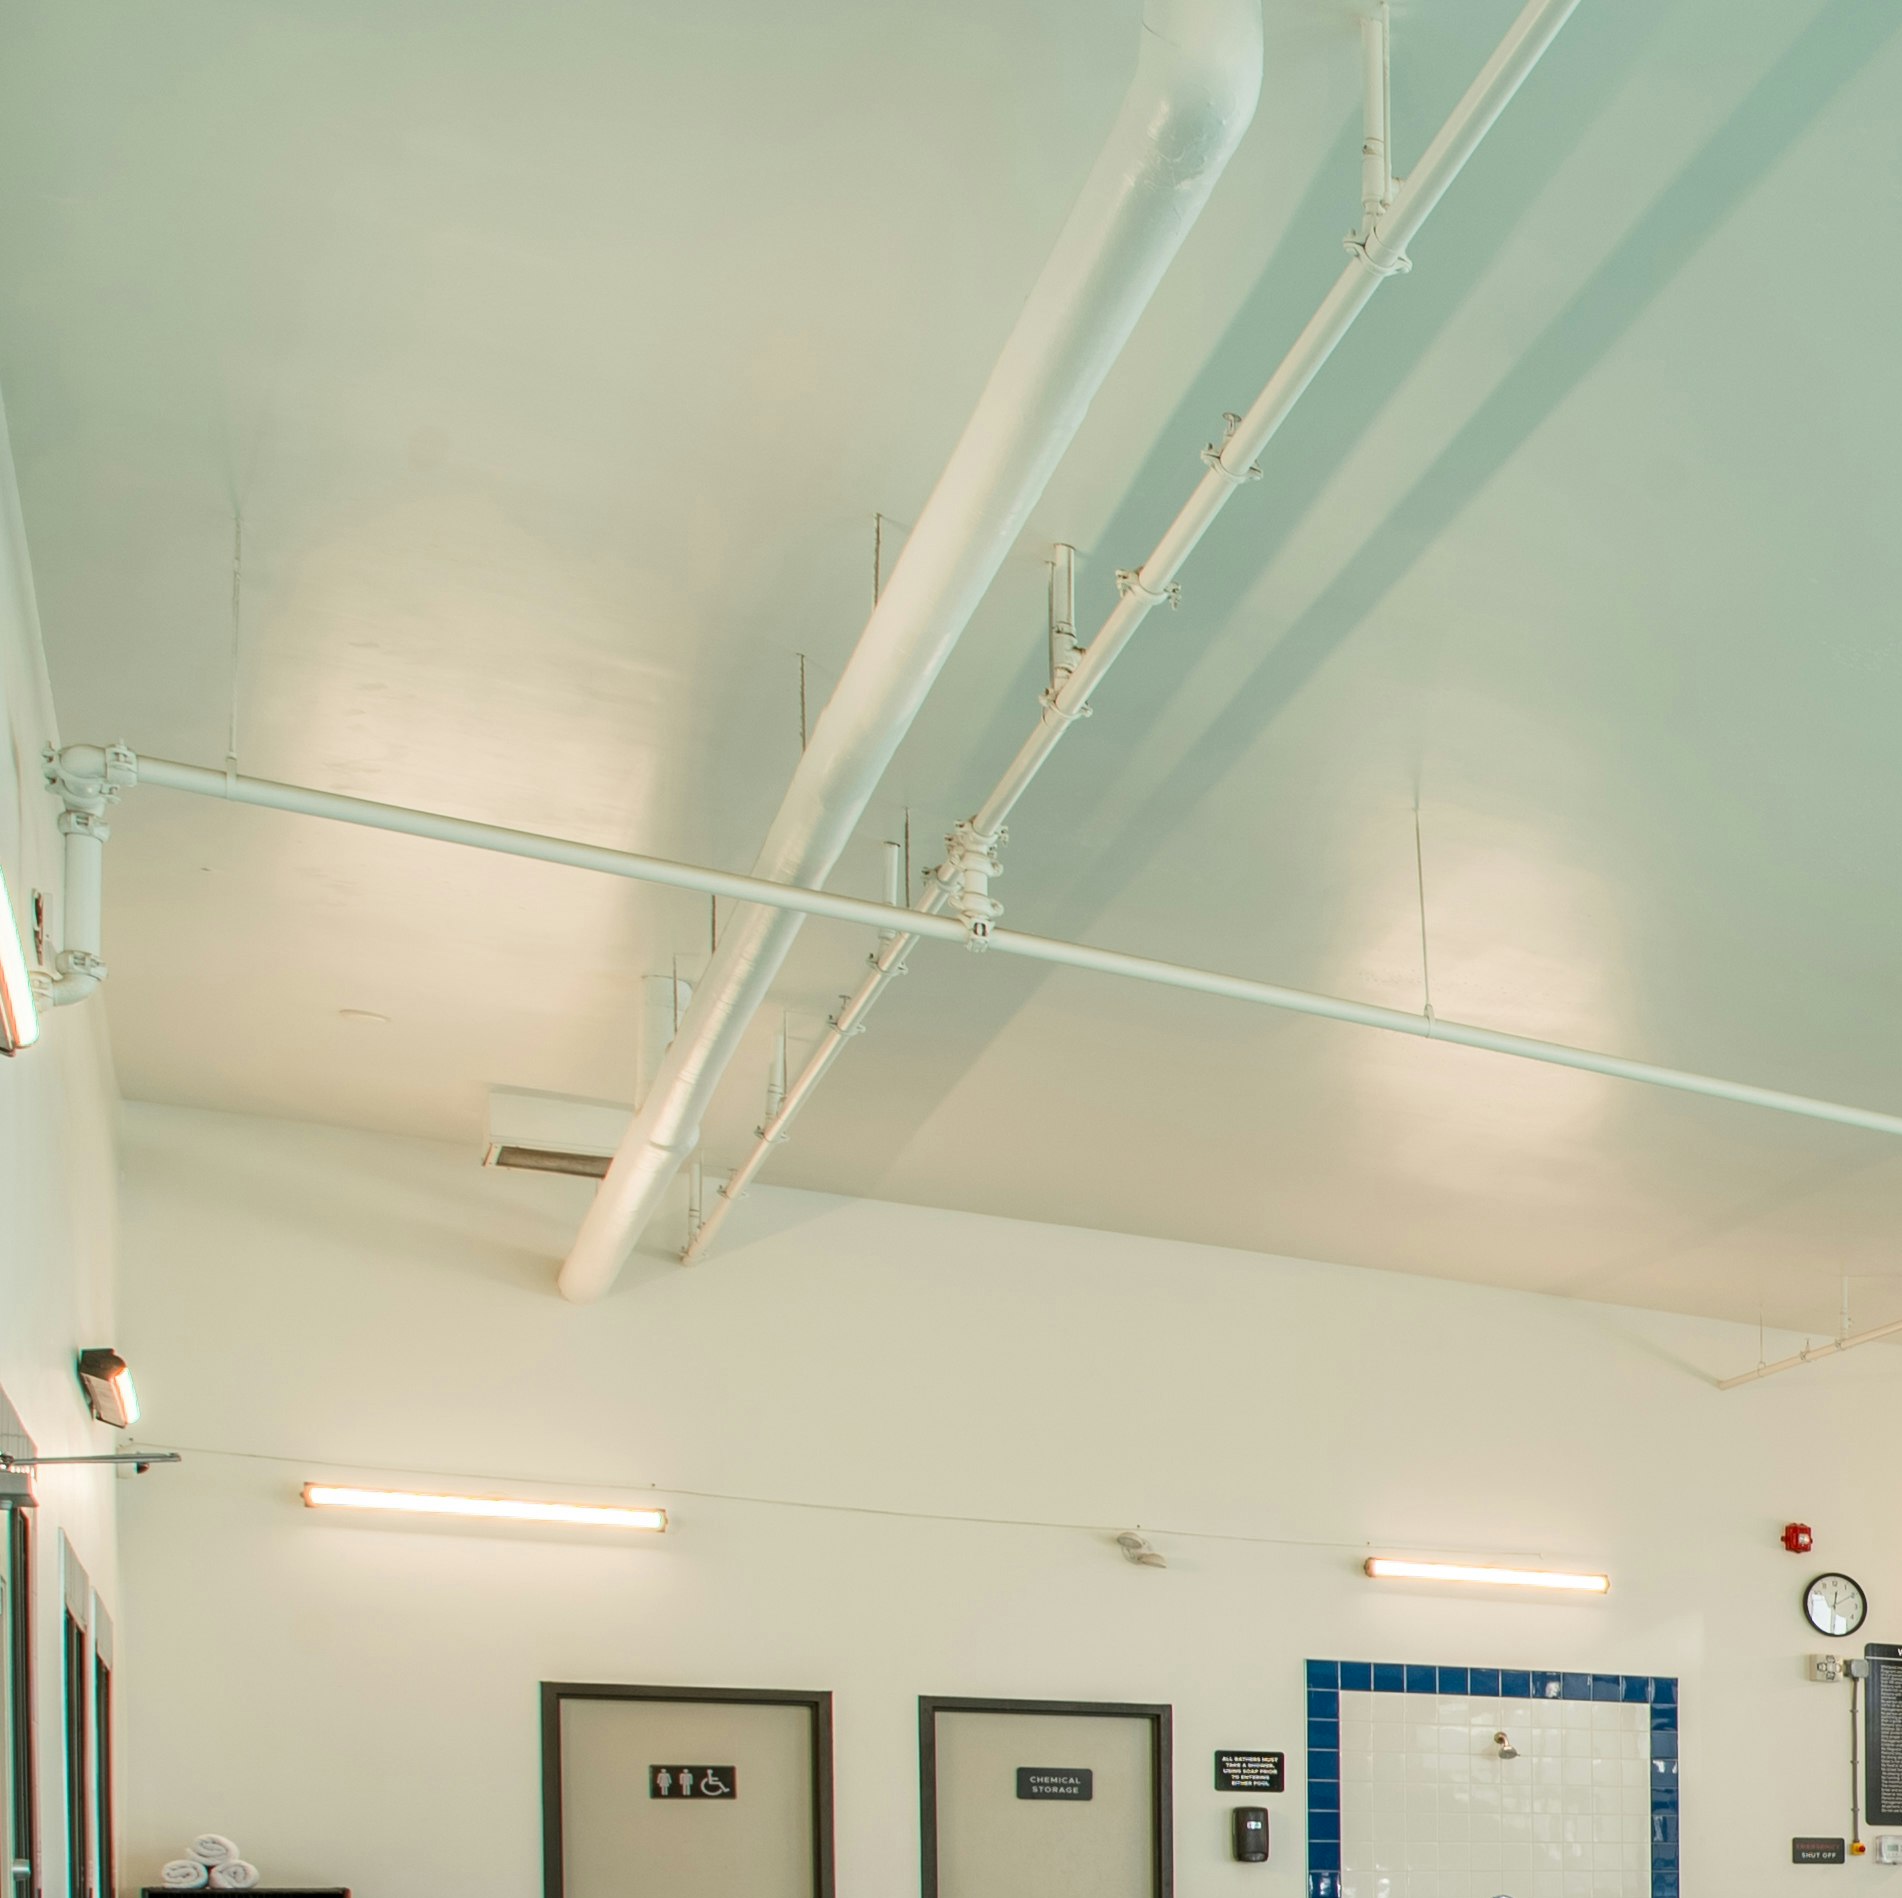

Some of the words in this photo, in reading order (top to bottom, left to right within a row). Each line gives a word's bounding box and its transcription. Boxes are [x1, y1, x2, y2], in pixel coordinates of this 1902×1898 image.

[1029, 1775, 1081, 1785] CHEMICAL
[1031, 1785, 1079, 1794] STORAGE
[1801, 1851, 1820, 1859] SHUT
